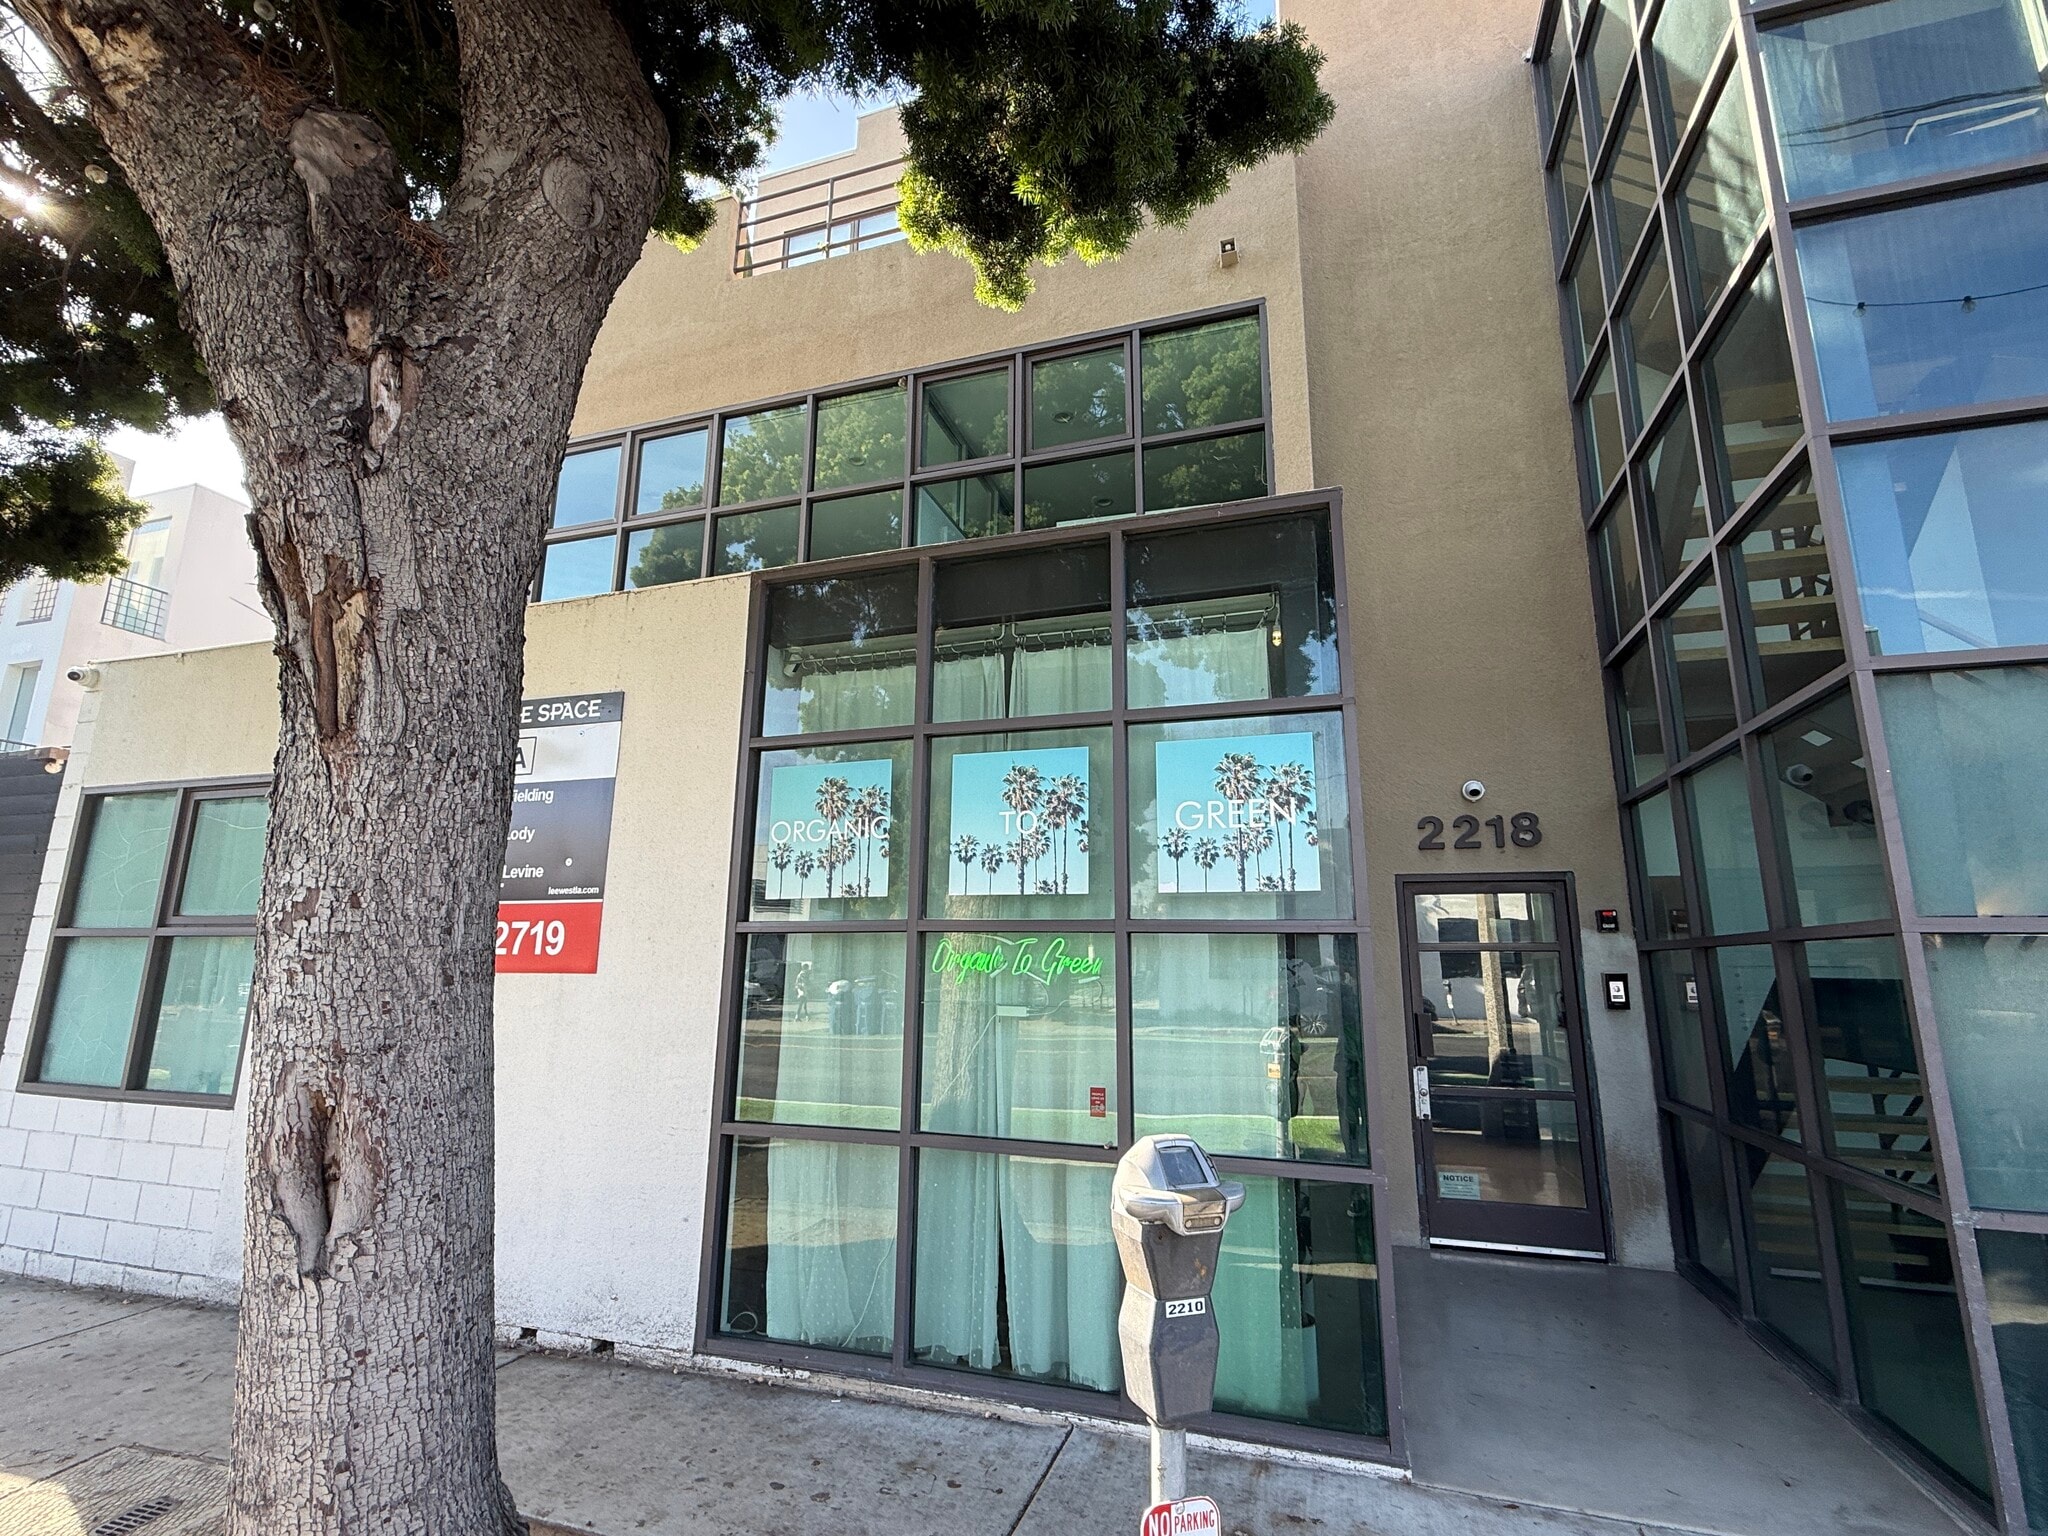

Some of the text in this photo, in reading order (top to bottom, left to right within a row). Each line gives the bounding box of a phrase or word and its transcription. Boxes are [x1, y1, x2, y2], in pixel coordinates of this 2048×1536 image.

[537, 699, 602, 722] SPACE
[998, 810, 1037, 835] TO
[1175, 796, 1297, 831] GREEN
[771, 815, 889, 843] ORGANIC
[1417, 811, 1543, 850] 2218
[502, 864, 544, 879] Levine
[548, 886, 599, 895] leewestla.com
[495, 920, 565, 956] 2719
[932, 937, 1104, 986] Organic To Green
[1442, 1174, 1475, 1183] NOTICE
[1168, 1300, 1204, 1316] 2210
[1148, 1508, 1215, 1536] NO PARKING
